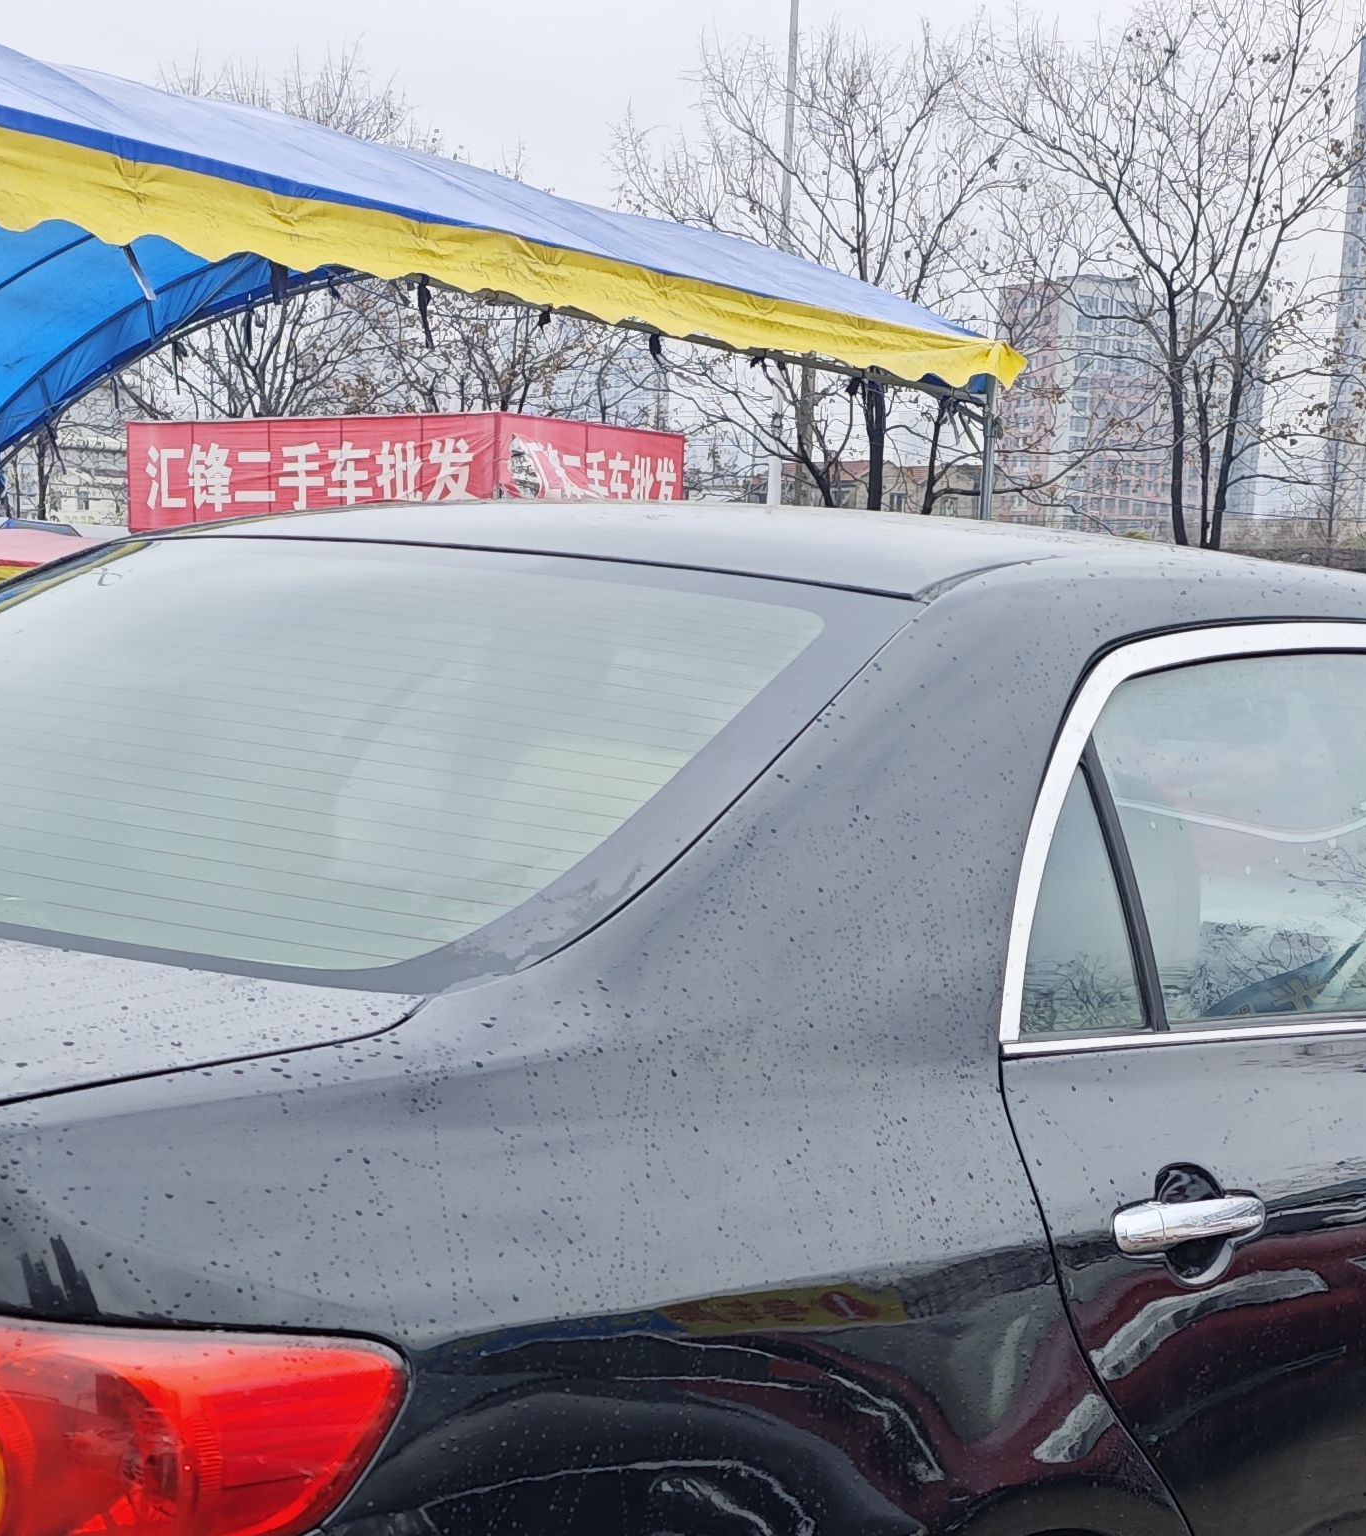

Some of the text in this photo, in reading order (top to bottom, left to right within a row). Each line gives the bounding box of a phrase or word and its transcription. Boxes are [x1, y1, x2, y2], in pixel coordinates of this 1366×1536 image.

[145, 437, 478, 512] 汇锋二手车批发
